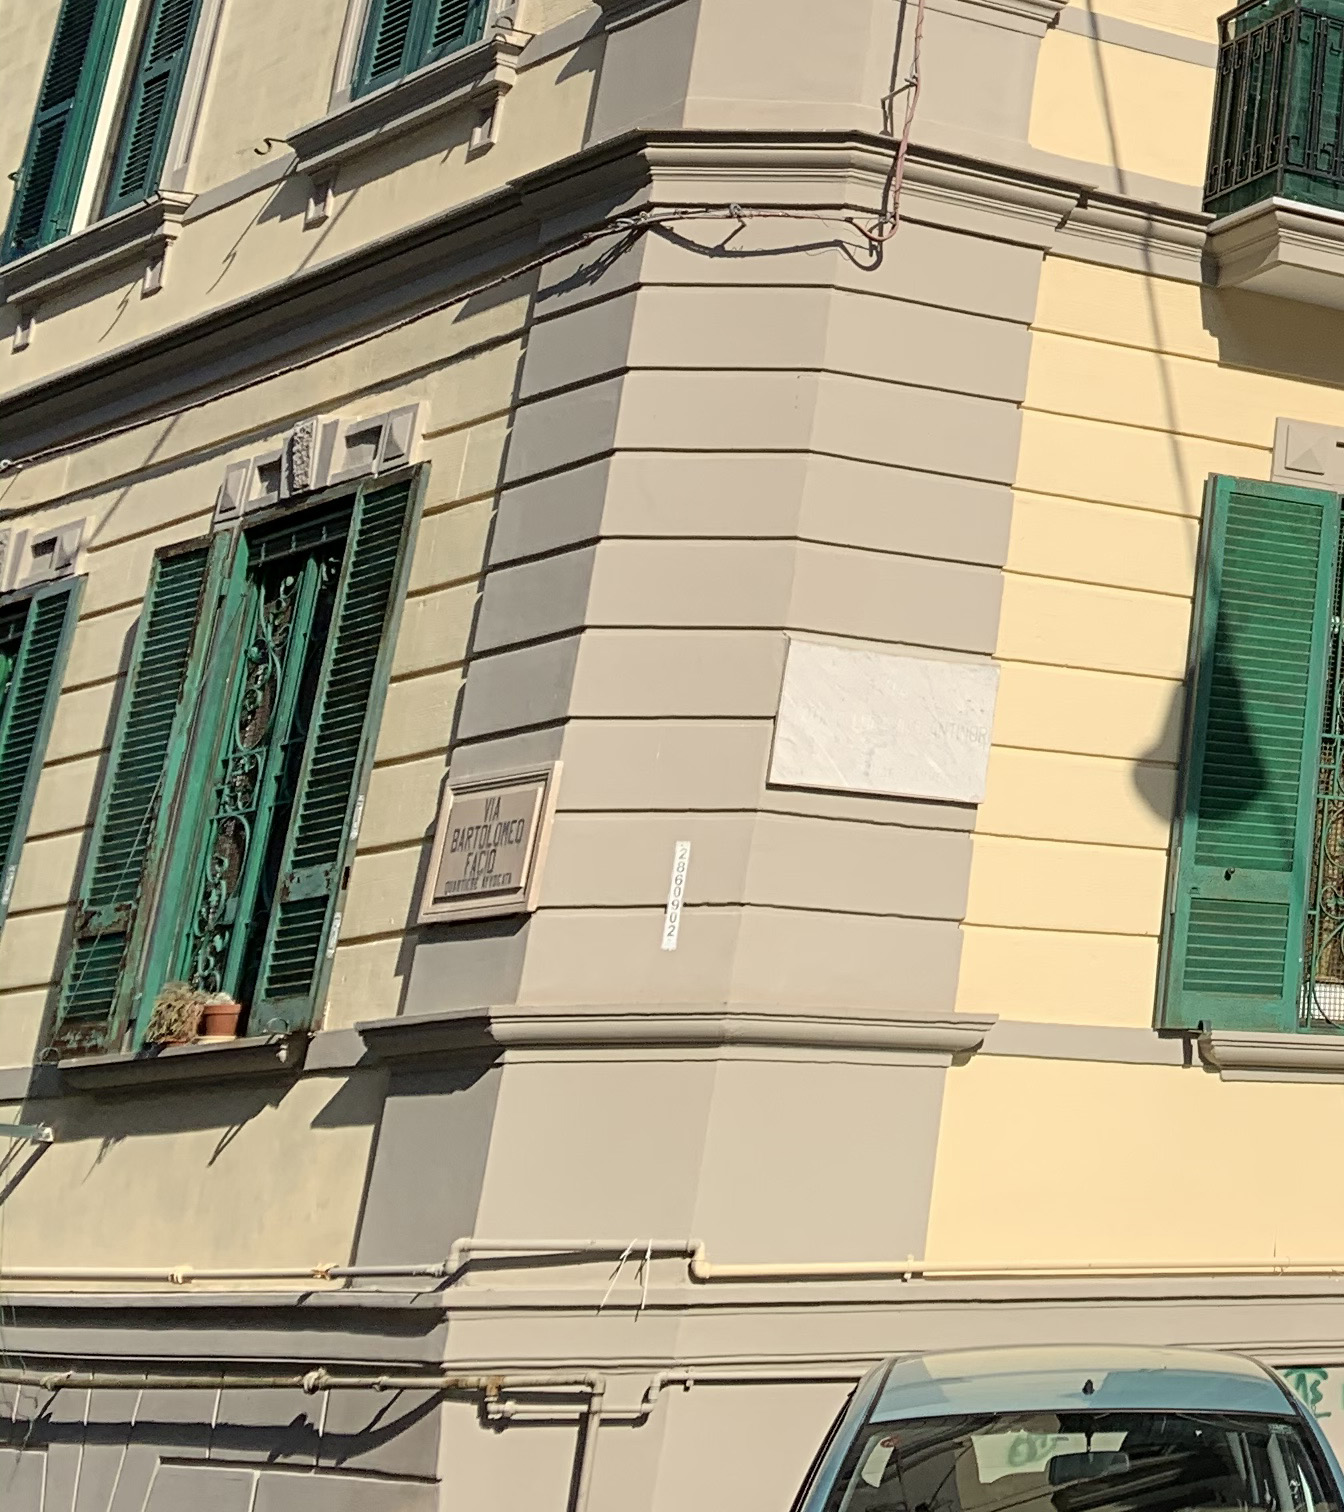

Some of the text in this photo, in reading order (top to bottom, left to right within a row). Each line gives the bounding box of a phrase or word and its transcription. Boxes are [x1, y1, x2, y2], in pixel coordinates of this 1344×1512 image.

[484, 796, 501, 823] VIA
[450, 818, 525, 854] BARTOLOMEO
[463, 848, 497, 878] FACIO
[667, 847, 688, 937] 2860902
